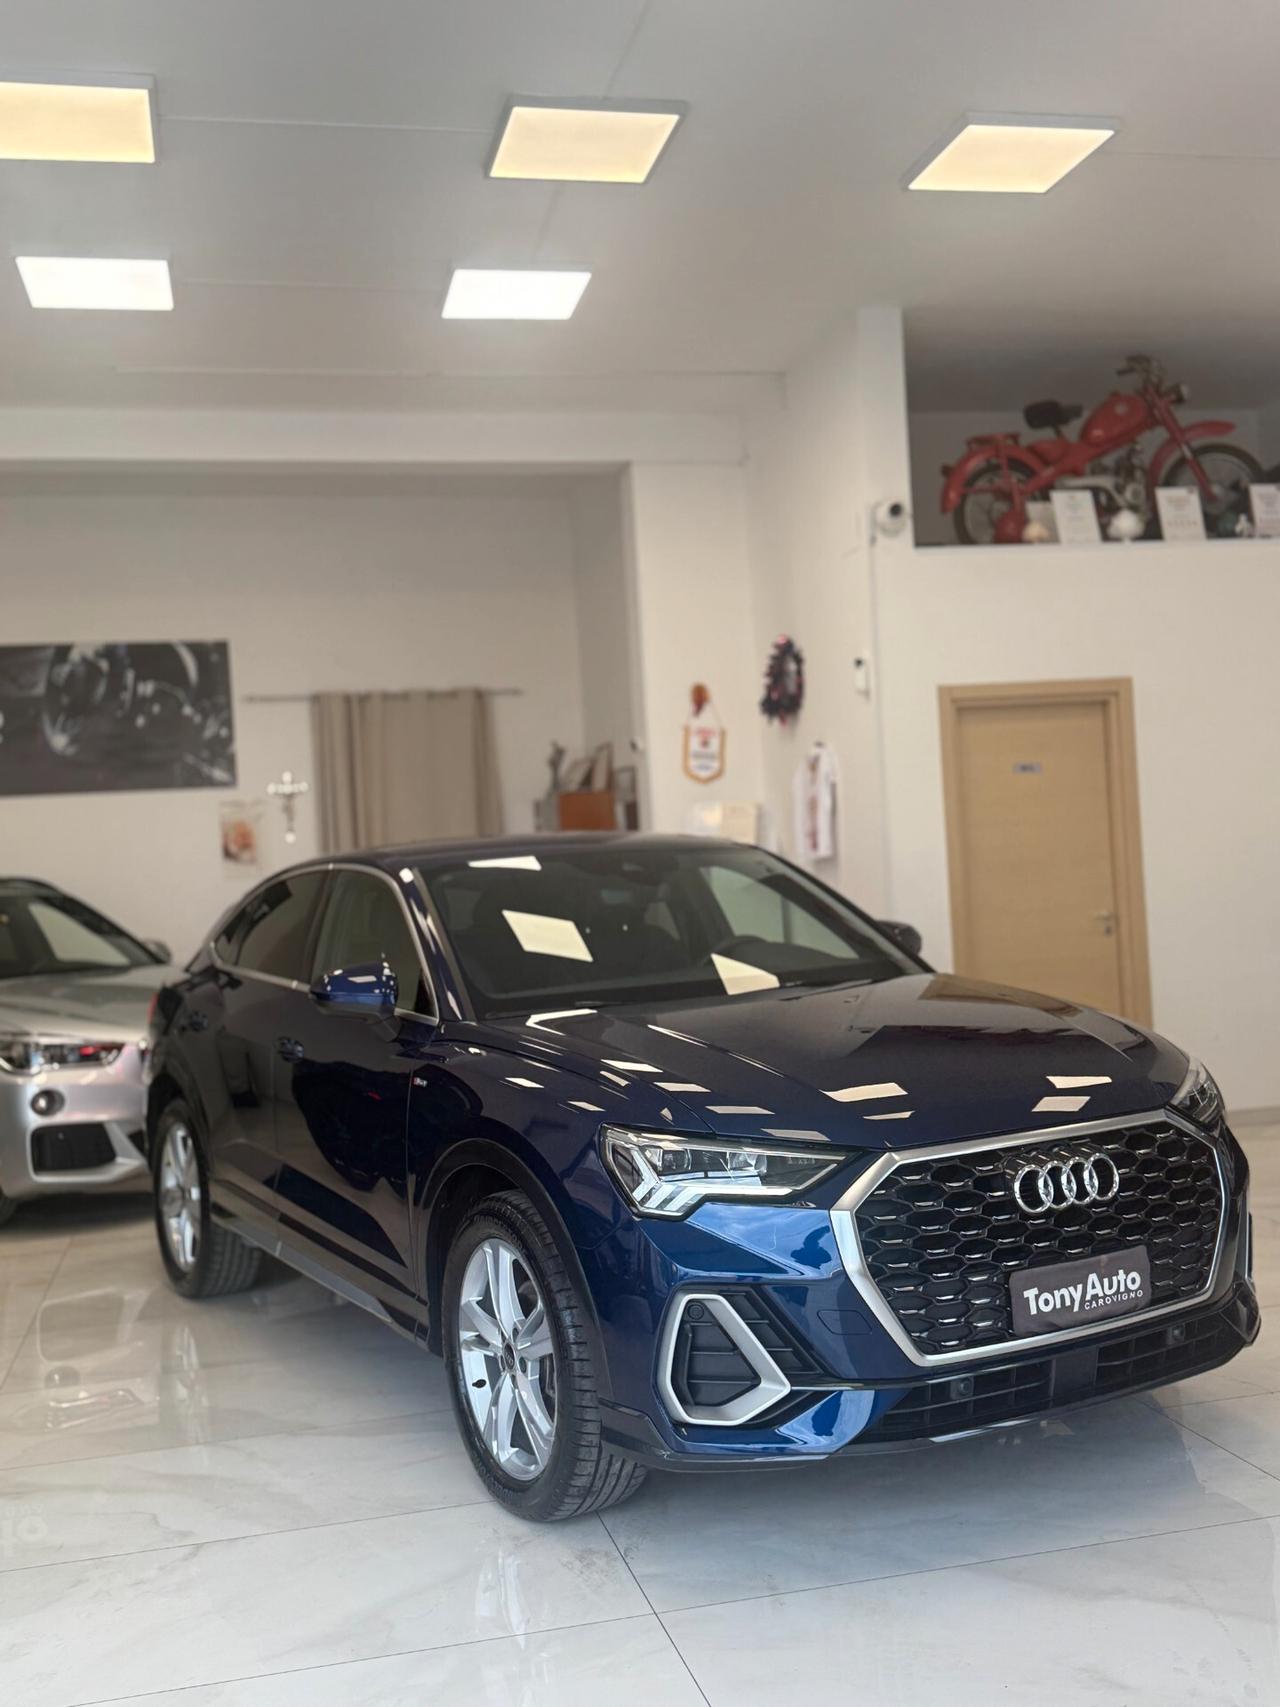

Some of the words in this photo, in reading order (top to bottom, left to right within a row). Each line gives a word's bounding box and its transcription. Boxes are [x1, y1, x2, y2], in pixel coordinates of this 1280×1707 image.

[1023, 1284, 1083, 1315] Tony
[1085, 1269, 1141, 1300] Auto
[1084, 1290, 1143, 1310] CAROVIGNO
